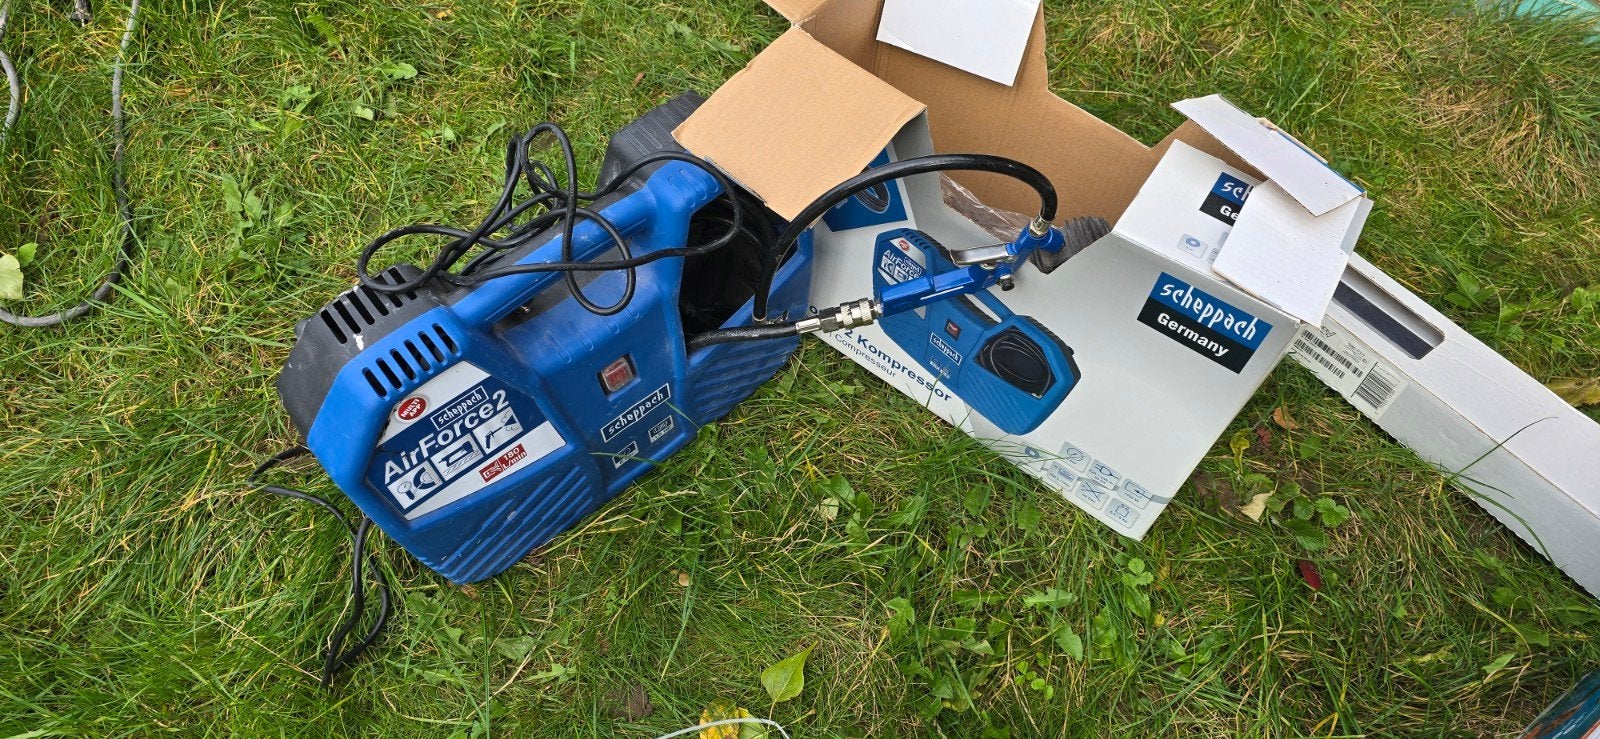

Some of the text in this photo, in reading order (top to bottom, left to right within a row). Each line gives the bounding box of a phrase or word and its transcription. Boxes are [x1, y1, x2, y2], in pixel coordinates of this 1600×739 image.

[1157, 312, 1229, 357] Germany
[1160, 284, 1258, 341] scheppach
[834, 333, 896, 379] Compresseur
[856, 334, 952, 402] Kompressor
[400, 398, 420, 418] MULTI
[409, 403, 421, 418] APP
[437, 391, 483, 424] scheppach
[608, 389, 664, 435] scheppach
[502, 447, 521, 461] 180
